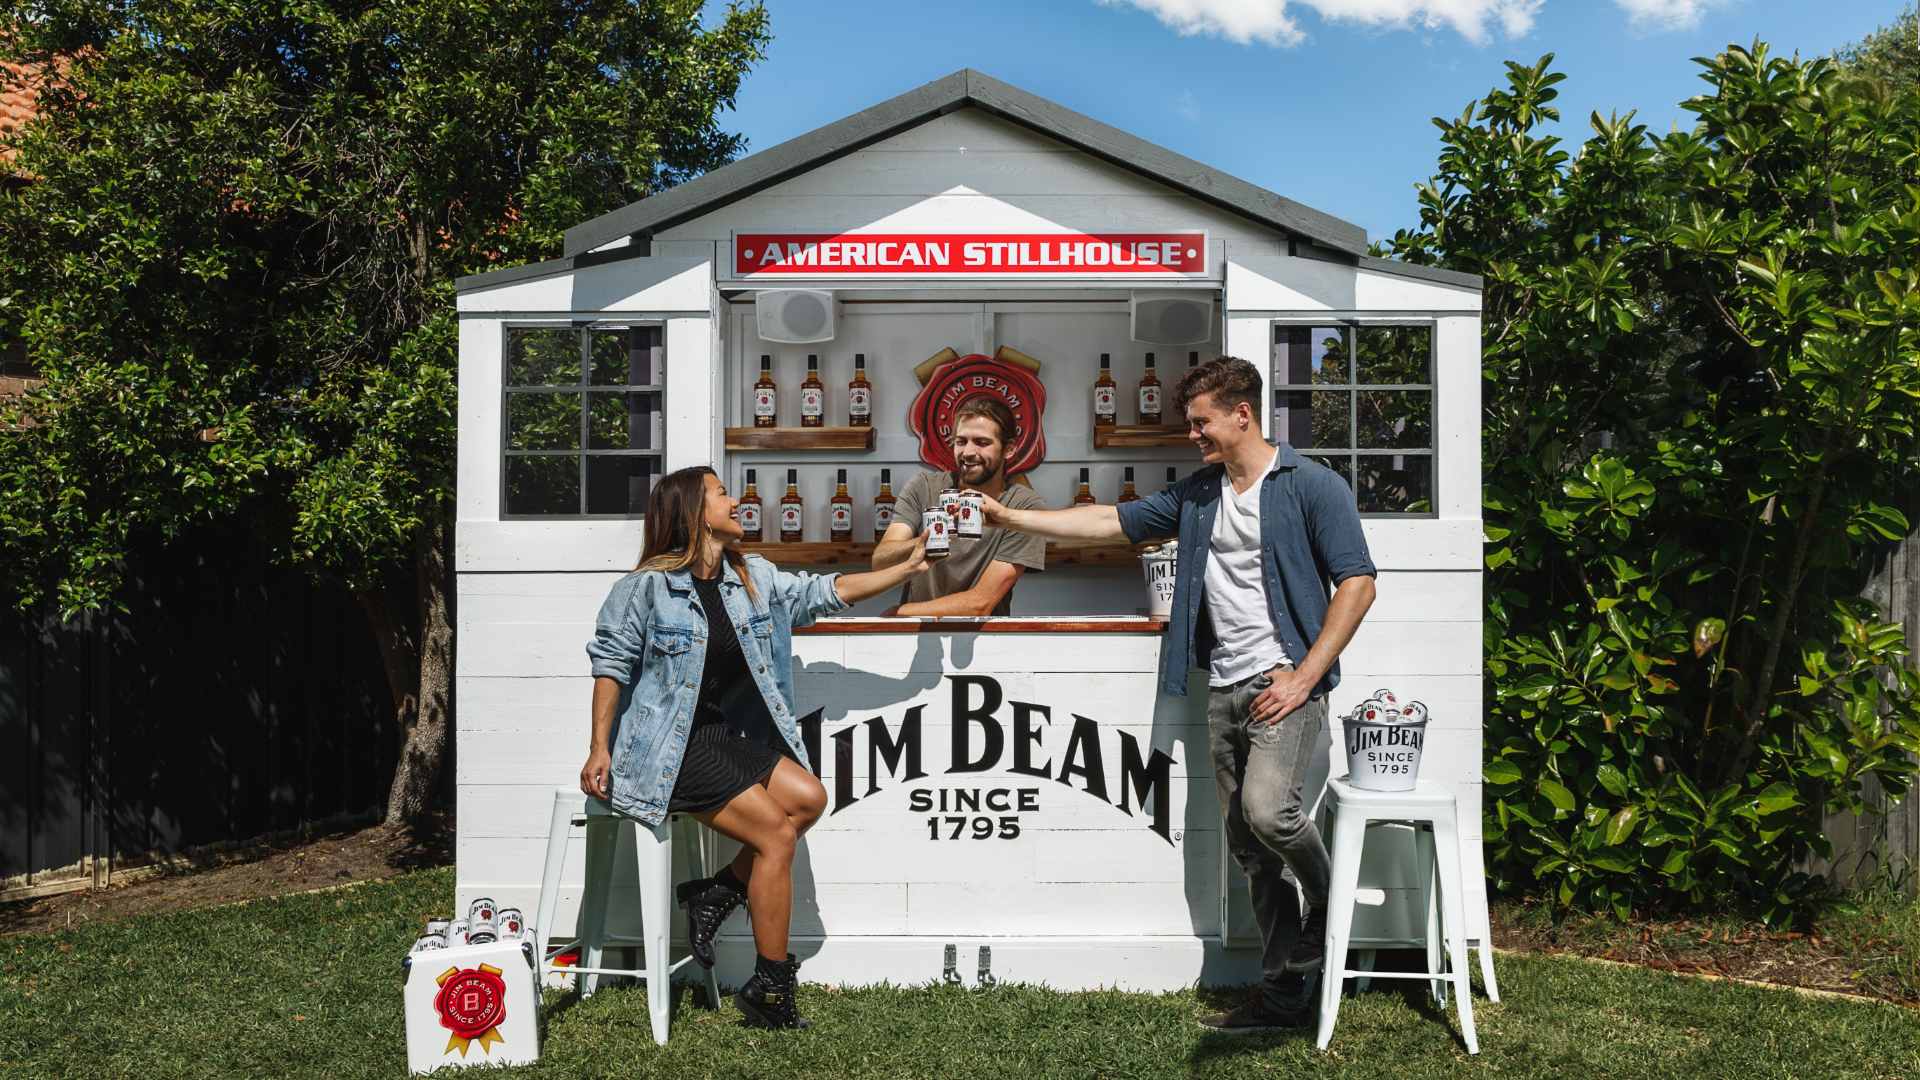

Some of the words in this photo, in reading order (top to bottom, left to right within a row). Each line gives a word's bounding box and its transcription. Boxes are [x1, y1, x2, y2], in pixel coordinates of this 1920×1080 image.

[759, 242, 950, 266] AMERICAN
[963, 242, 1182, 266] STILLHOUSE
[943, 383, 966, 409] JIM
[972, 376, 1021, 409] BEAM
[1147, 563, 1166, 585] JIM
[1156, 583, 1176, 591] SIN
[1160, 592, 1173, 601] 17
[1351, 727, 1382, 755] JIM
[796, 703, 929, 816] JIM
[944, 674, 1178, 848] BEAM
[1368, 752, 1414, 762] SINCE
[1372, 765, 1409, 774] 1795
[909, 788, 1040, 812] SINCE
[927, 816, 1021, 840] 1795
[451, 984, 463, 998] JIM
[466, 980, 492, 995] BEAM
[450, 1006, 474, 1024] SINCE
[478, 1003, 494, 1021] 1795
